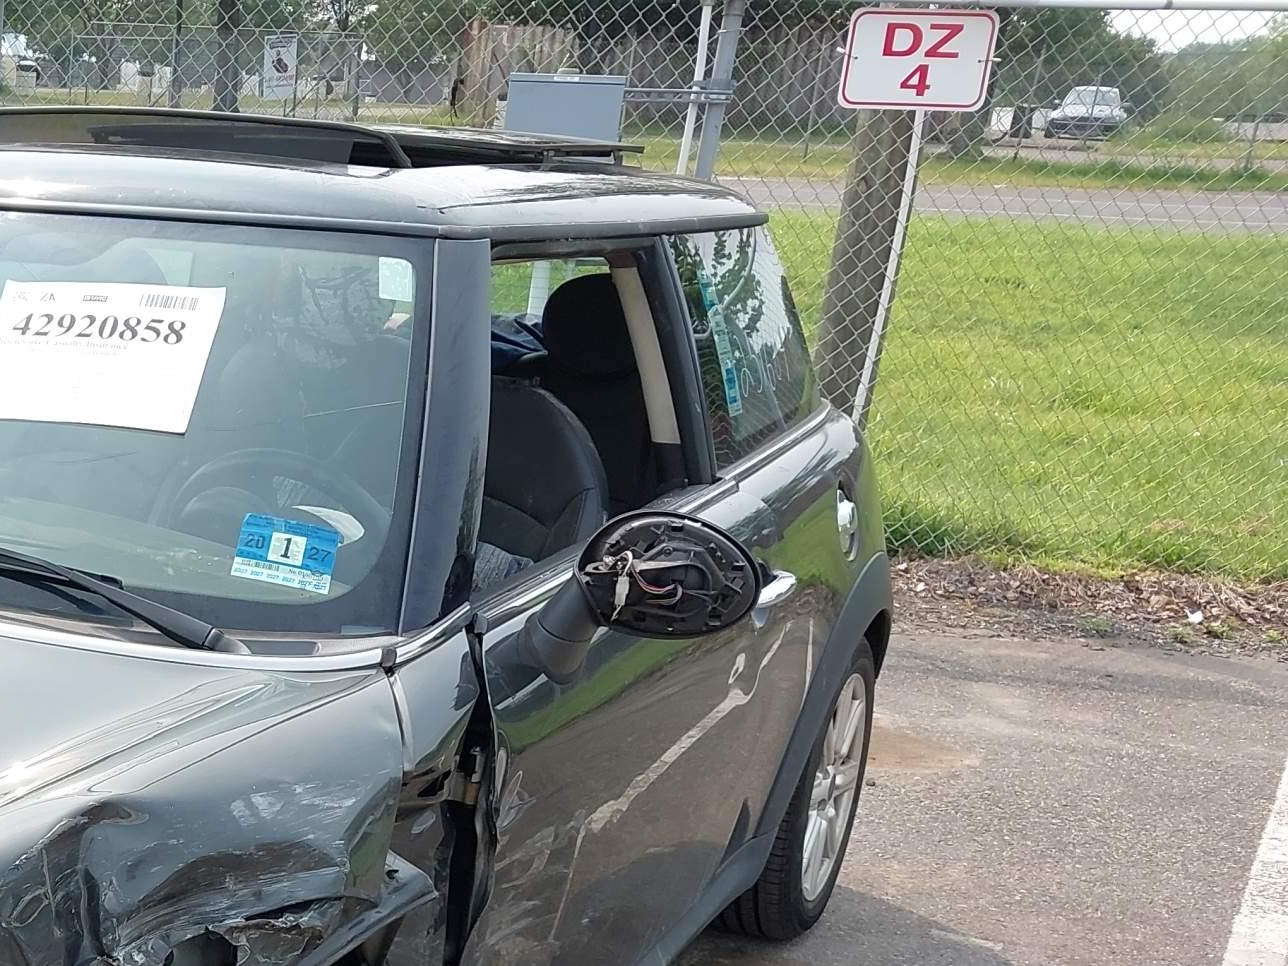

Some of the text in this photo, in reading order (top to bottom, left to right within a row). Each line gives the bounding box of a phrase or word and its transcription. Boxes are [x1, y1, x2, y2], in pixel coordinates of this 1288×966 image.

[882, 22, 965, 59] DZ
[900, 63, 931, 97] 4
[12, 312, 187, 346] 42920858
[244, 533, 332, 563] 20 1 27
